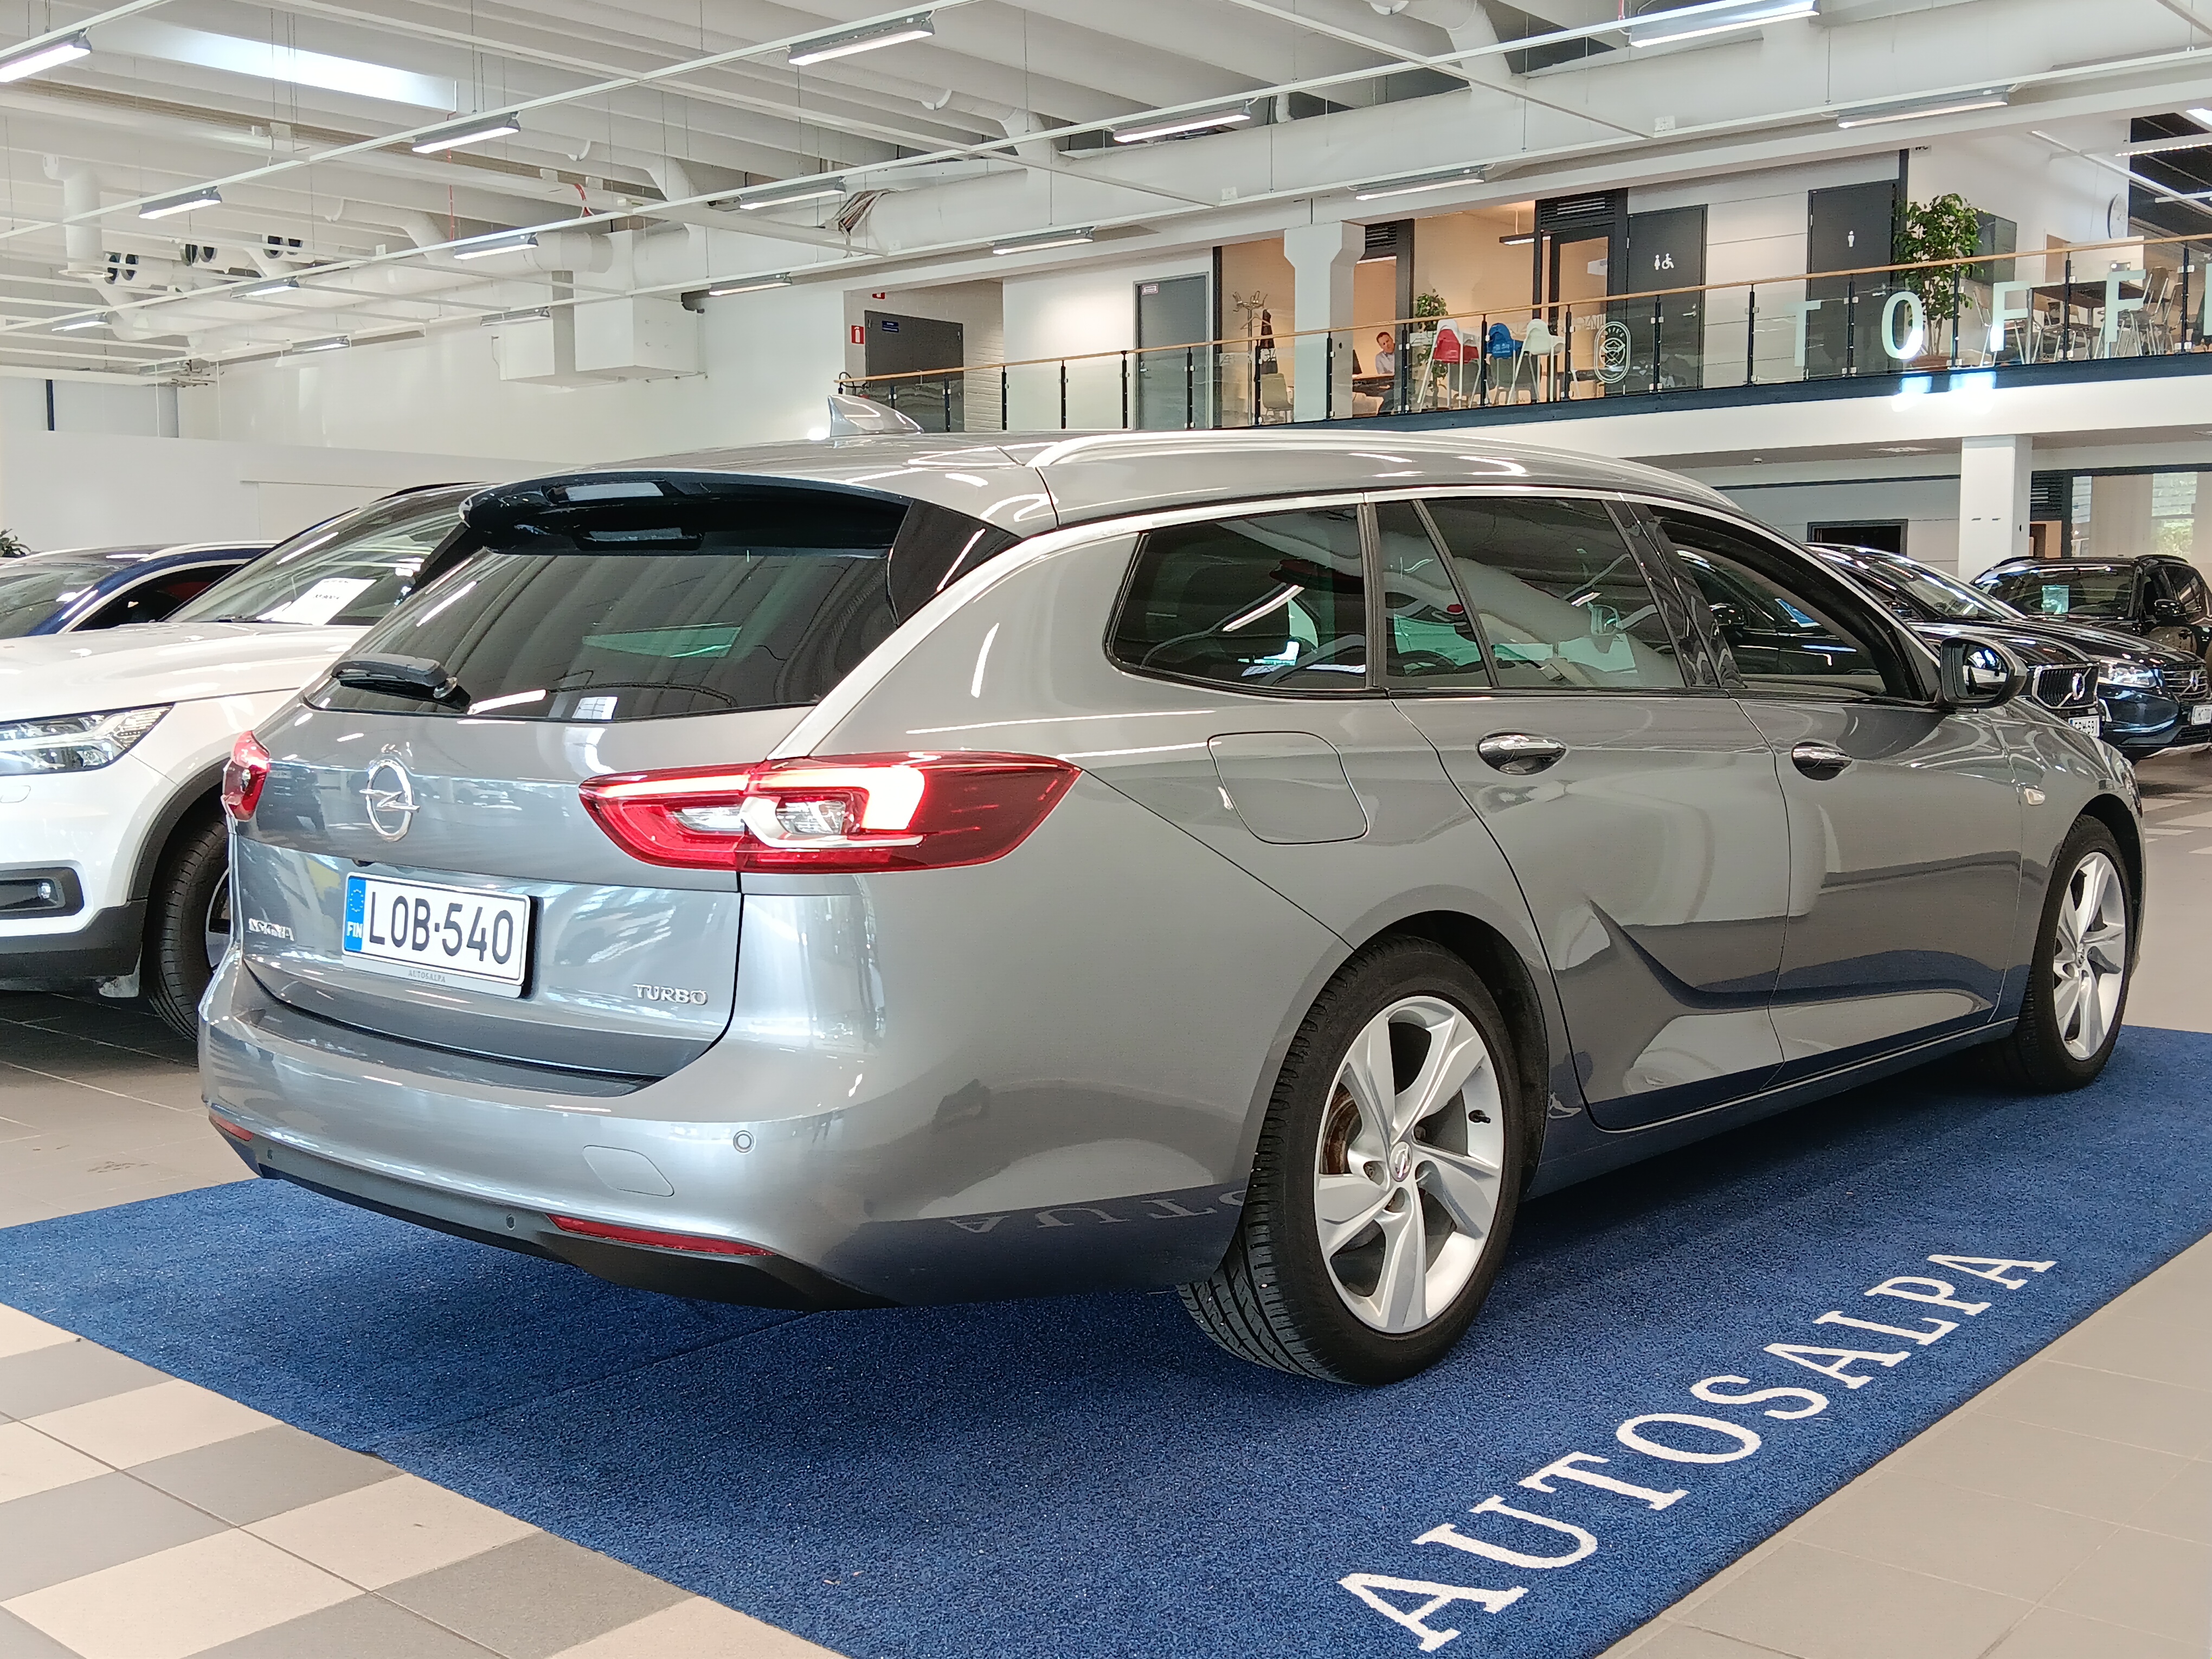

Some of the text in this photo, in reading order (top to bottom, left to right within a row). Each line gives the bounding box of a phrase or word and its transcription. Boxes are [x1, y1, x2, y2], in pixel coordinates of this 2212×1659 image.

[1783, 263, 2212, 367] TOFF
[347, 921, 363, 938] FIN
[369, 891, 514, 964] LOB-540
[408, 969, 446, 983] AUTOSALPA
[632, 983, 708, 1006] TURBO
[1338, 1253, 2057, 1652] AUTOSALPA
